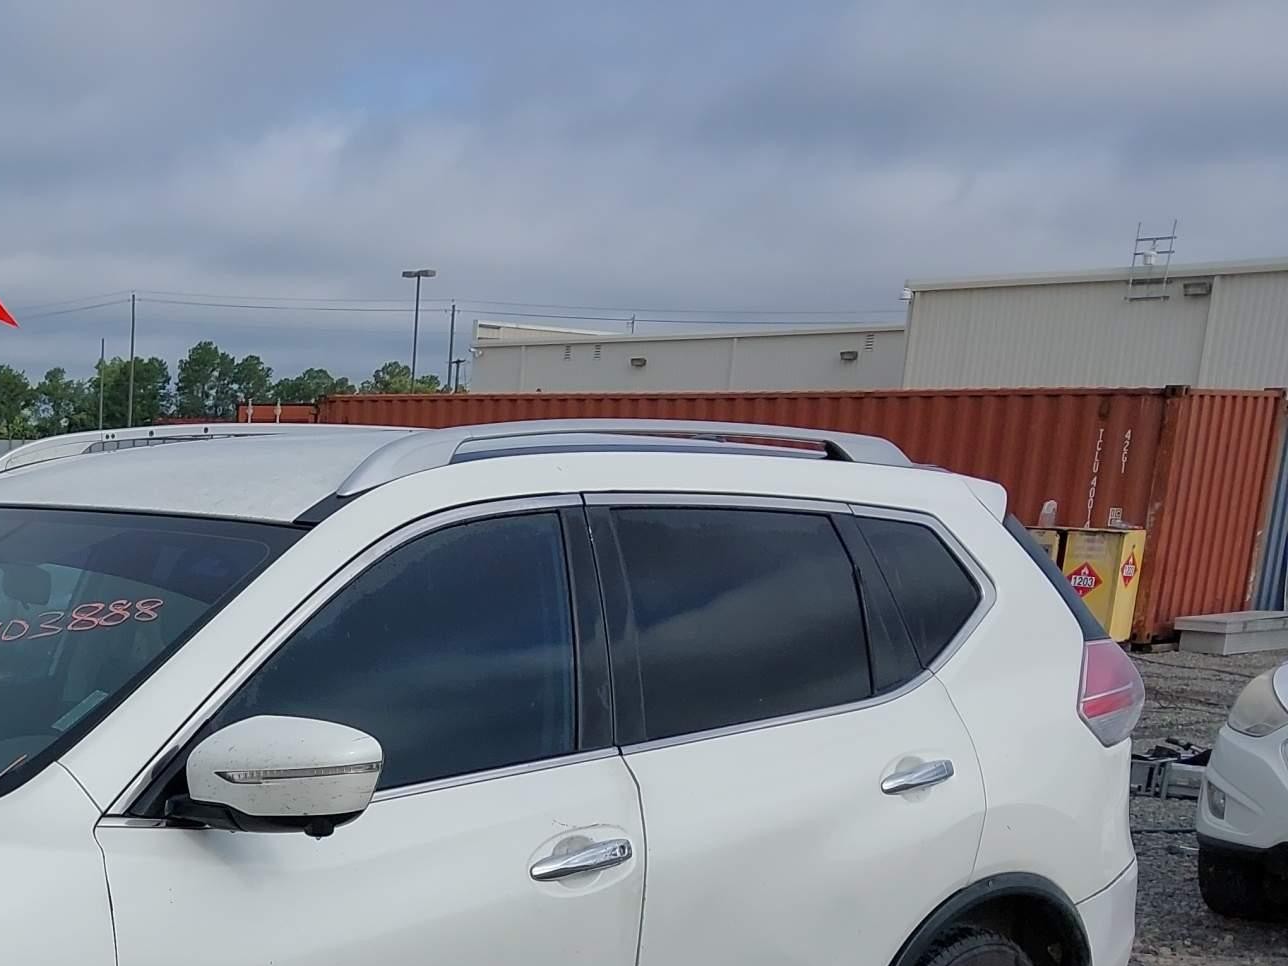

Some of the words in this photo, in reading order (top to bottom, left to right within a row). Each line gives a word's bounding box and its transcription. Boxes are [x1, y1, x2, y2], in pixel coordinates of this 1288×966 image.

[1093, 429, 1104, 473] TCLU
[1121, 429, 1131, 473] 42G1
[1073, 576, 1094, 587] 1203
